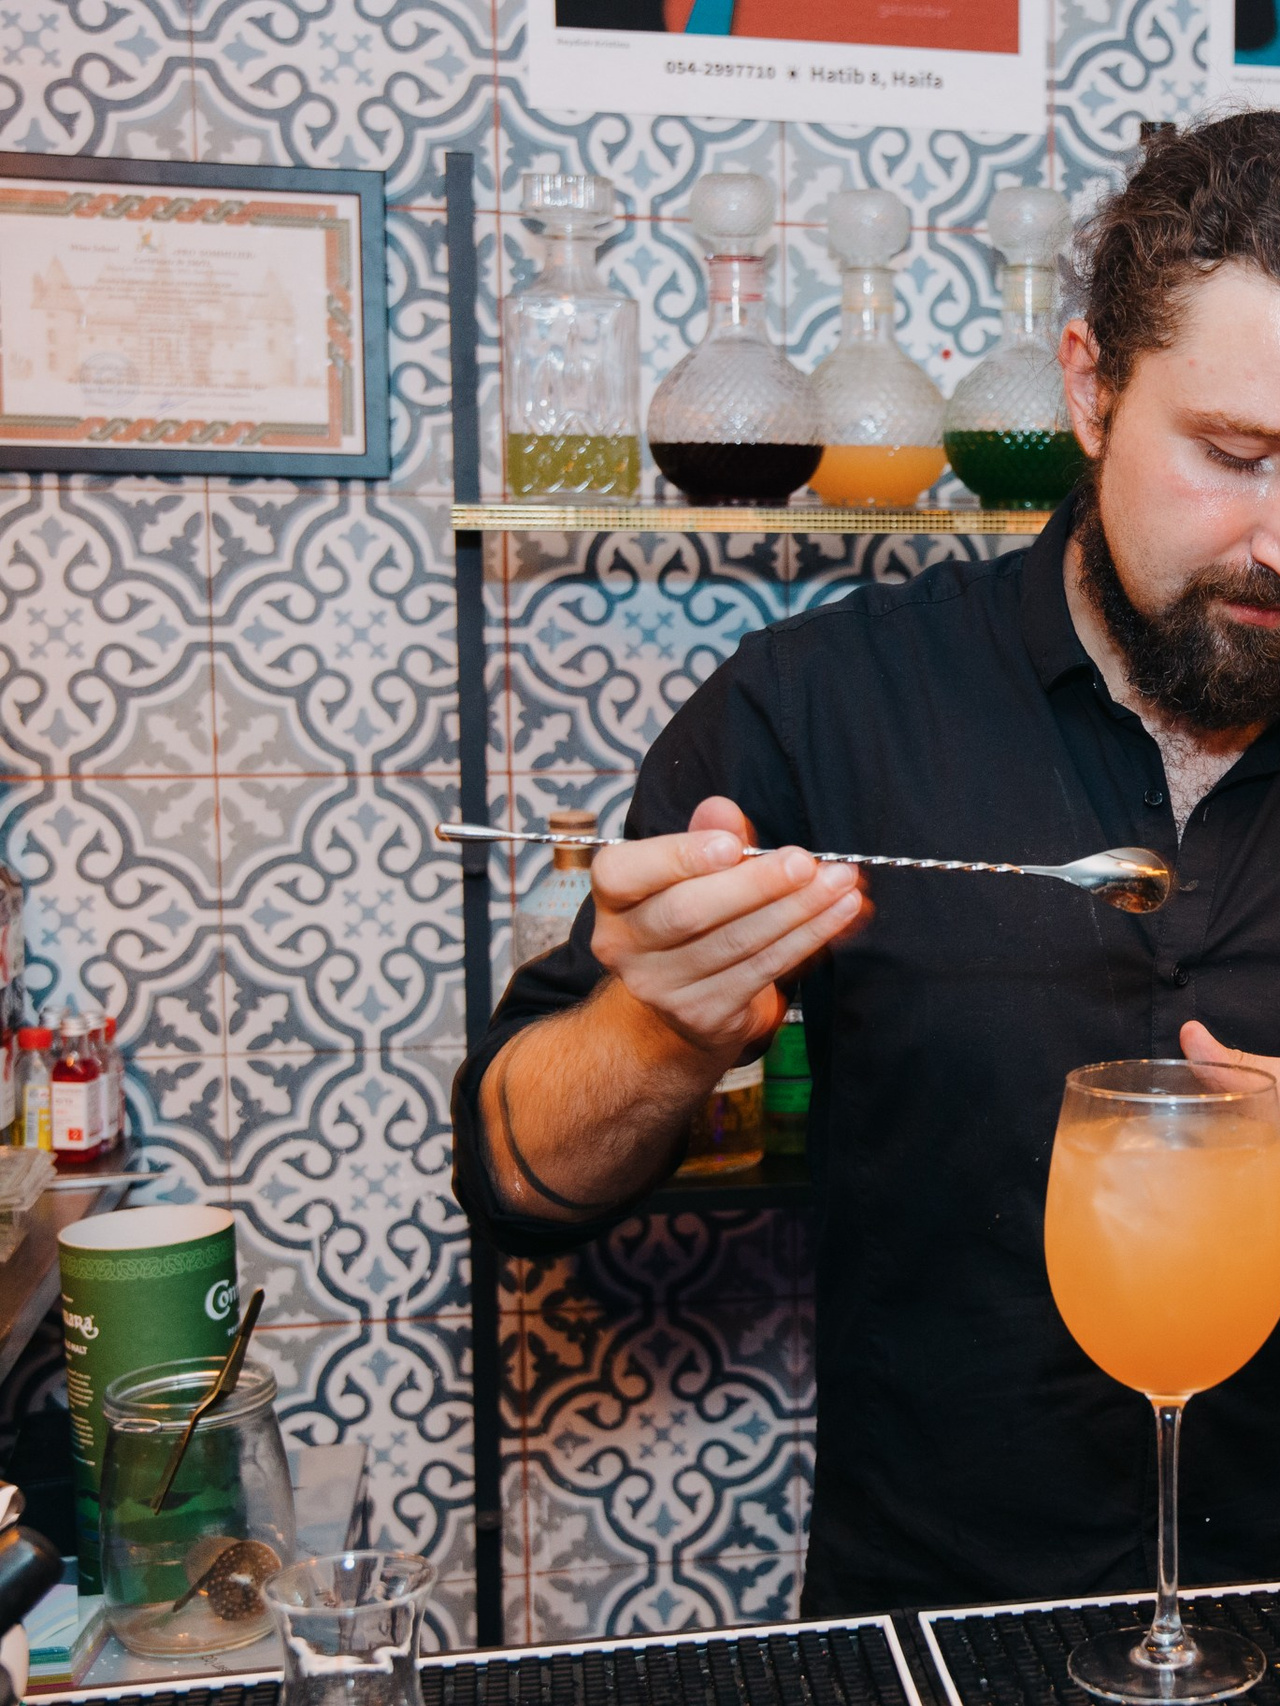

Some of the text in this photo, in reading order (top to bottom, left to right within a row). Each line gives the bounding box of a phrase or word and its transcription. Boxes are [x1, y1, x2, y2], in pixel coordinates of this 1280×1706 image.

[665, 60, 776, 79] 054-2997710
[811, 66, 865, 85] Hatib
[893, 70, 944, 89] Haifa
